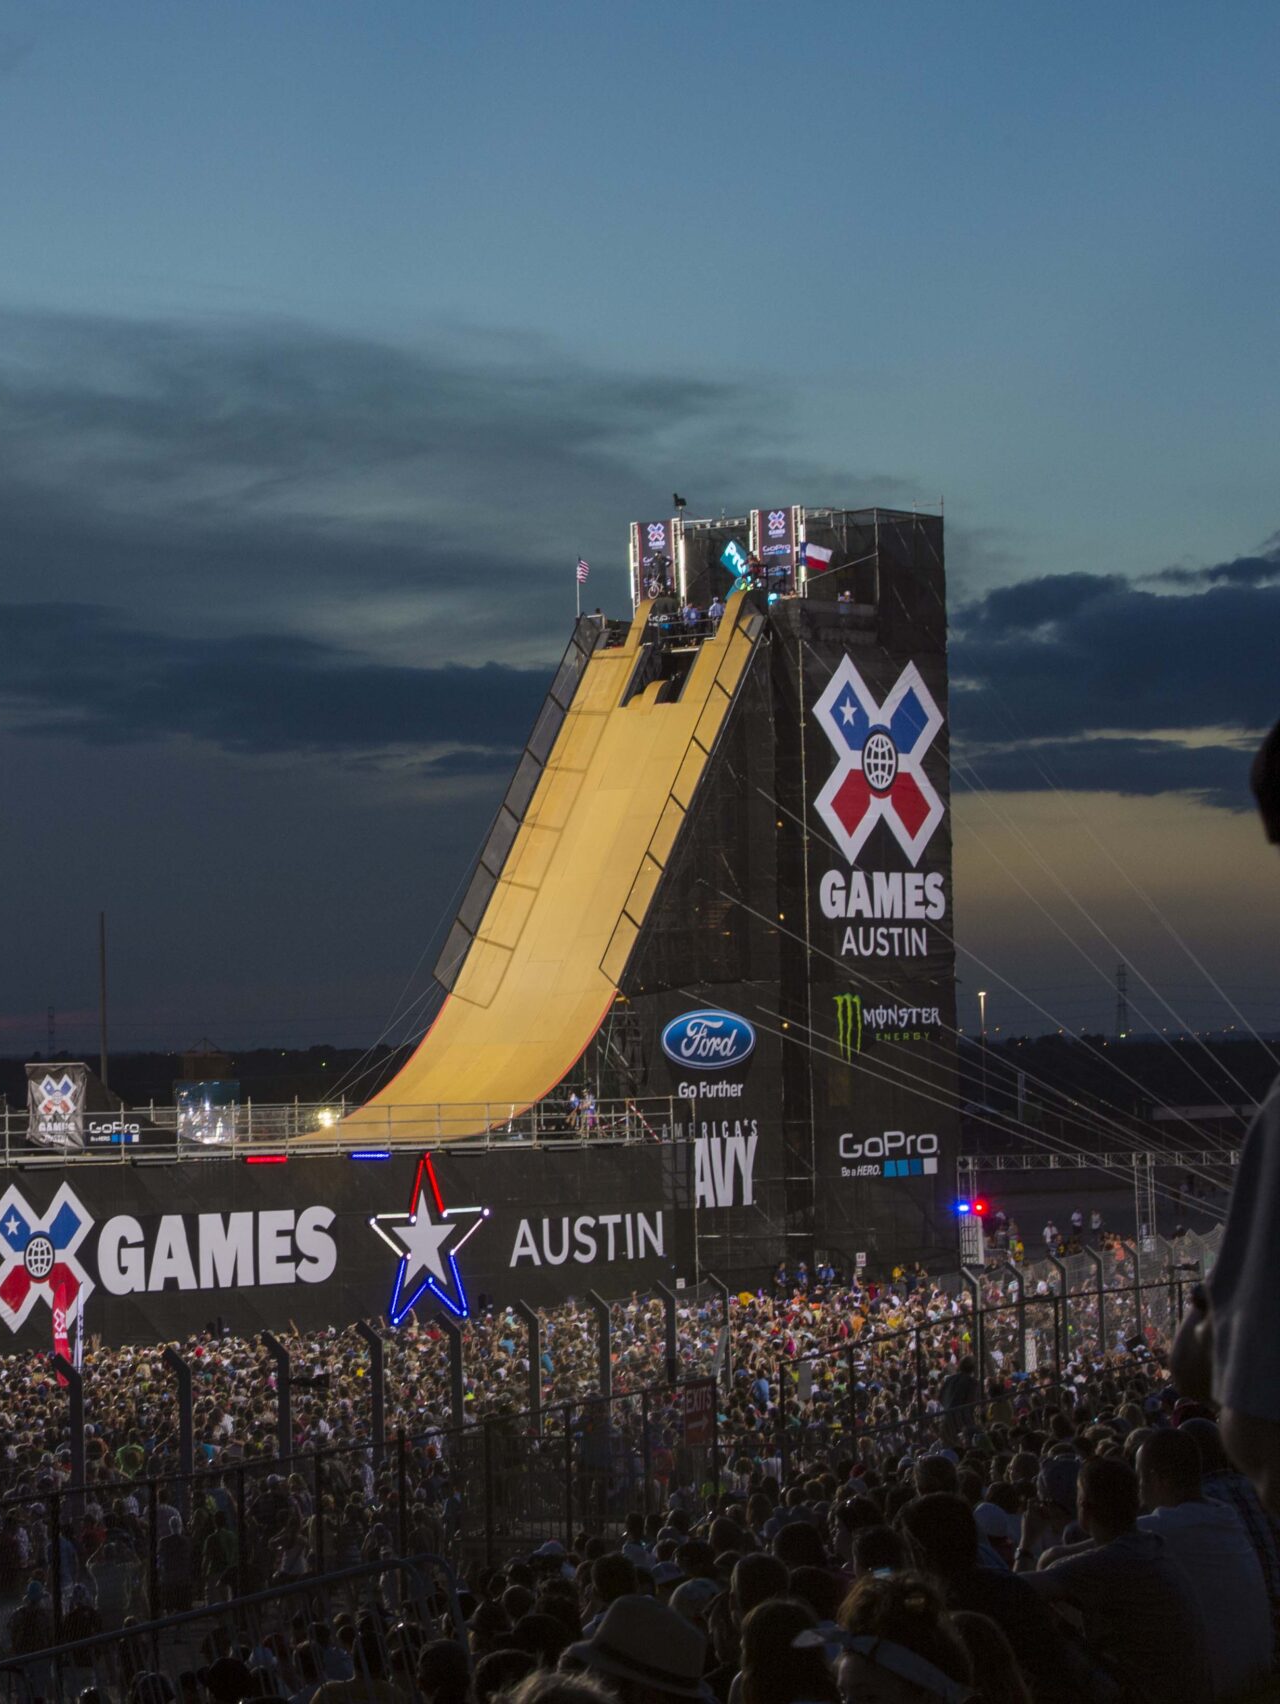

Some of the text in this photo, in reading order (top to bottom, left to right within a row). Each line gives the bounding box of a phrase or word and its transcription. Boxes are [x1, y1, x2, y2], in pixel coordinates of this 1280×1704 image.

[819, 869, 946, 920] GAMES
[841, 926, 928, 957] AUSTIN
[681, 1019, 738, 1058] Ford
[875, 1031, 931, 1042] ENERGY
[678, 1080, 744, 1098] Go Further
[89, 1121, 140, 1134] GoPro
[839, 1130, 939, 1159] GoPro
[662, 1136, 759, 1209] AVY
[841, 1166, 851, 1178] Be
[97, 1205, 338, 1296] GAMES
[509, 1210, 665, 1268] AUSTIN
[686, 1384, 713, 1414] EXITS
